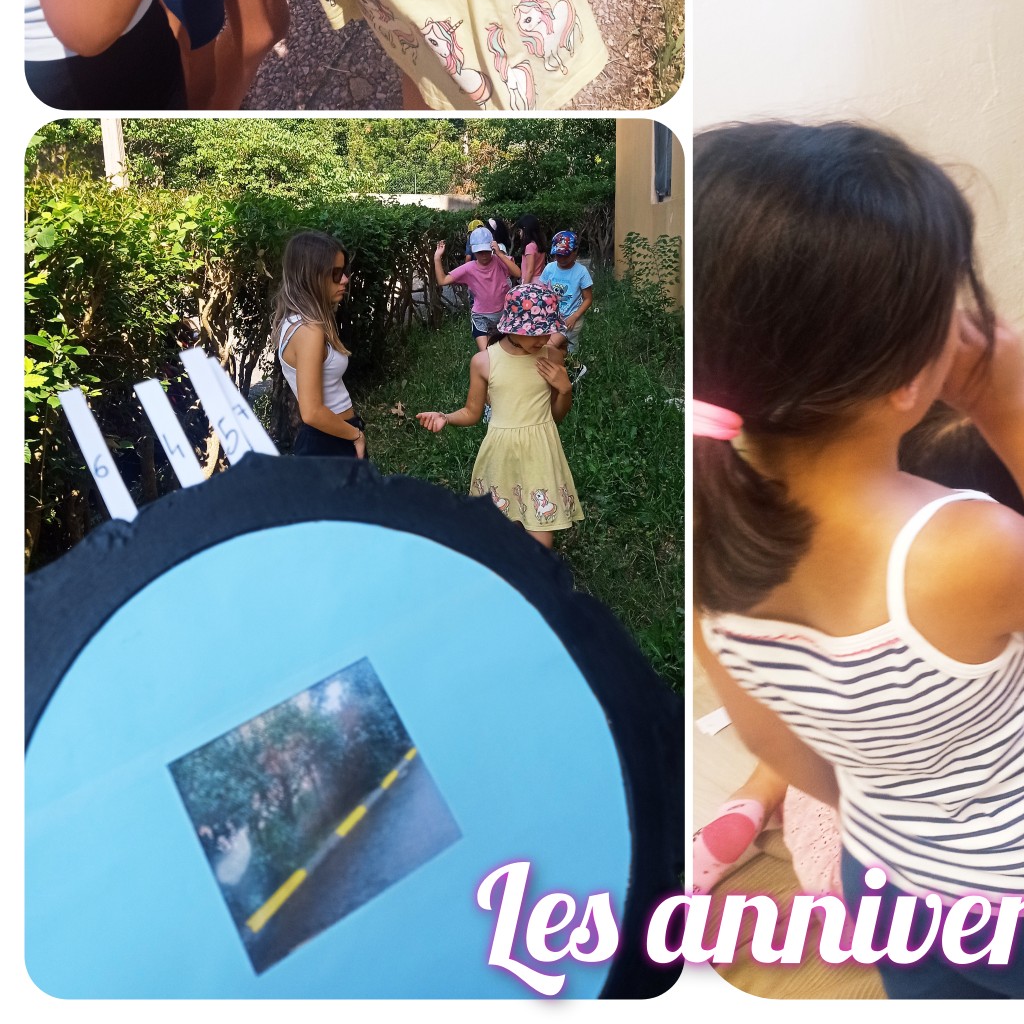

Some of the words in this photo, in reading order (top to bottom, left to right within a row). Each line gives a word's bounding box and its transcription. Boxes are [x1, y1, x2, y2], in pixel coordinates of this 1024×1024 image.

[162, 434, 186, 459] 4
[217, 416, 239, 456] 5
[93, 453, 110, 478] 6
